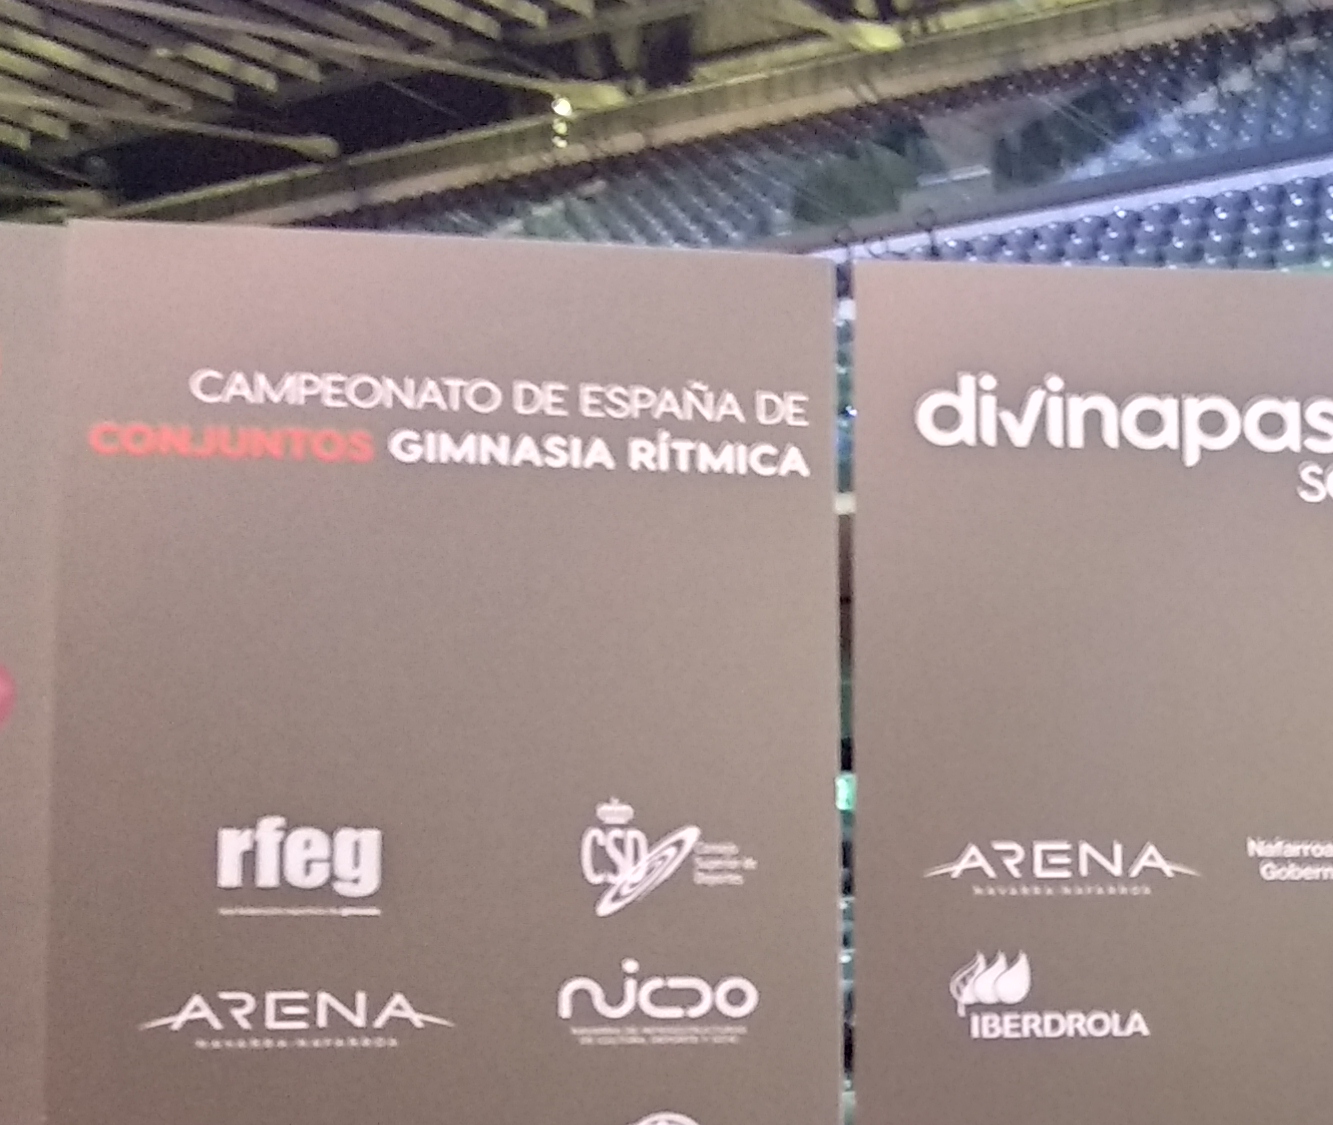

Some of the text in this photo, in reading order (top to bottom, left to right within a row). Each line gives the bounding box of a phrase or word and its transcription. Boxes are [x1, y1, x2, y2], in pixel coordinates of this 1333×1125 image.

[188, 367, 811, 427] CAMPEONATO DE ESPAÑA DE
[88, 421, 811, 477] CONJUNTOS GIMNASIA RÍTMICA
[216, 815, 382, 898] rfeg
[580, 823, 649, 886] CSD
[927, 839, 1197, 880] ARENA
[144, 990, 452, 1031] ARENA
[969, 1010, 1151, 1039] IBERDROLA
